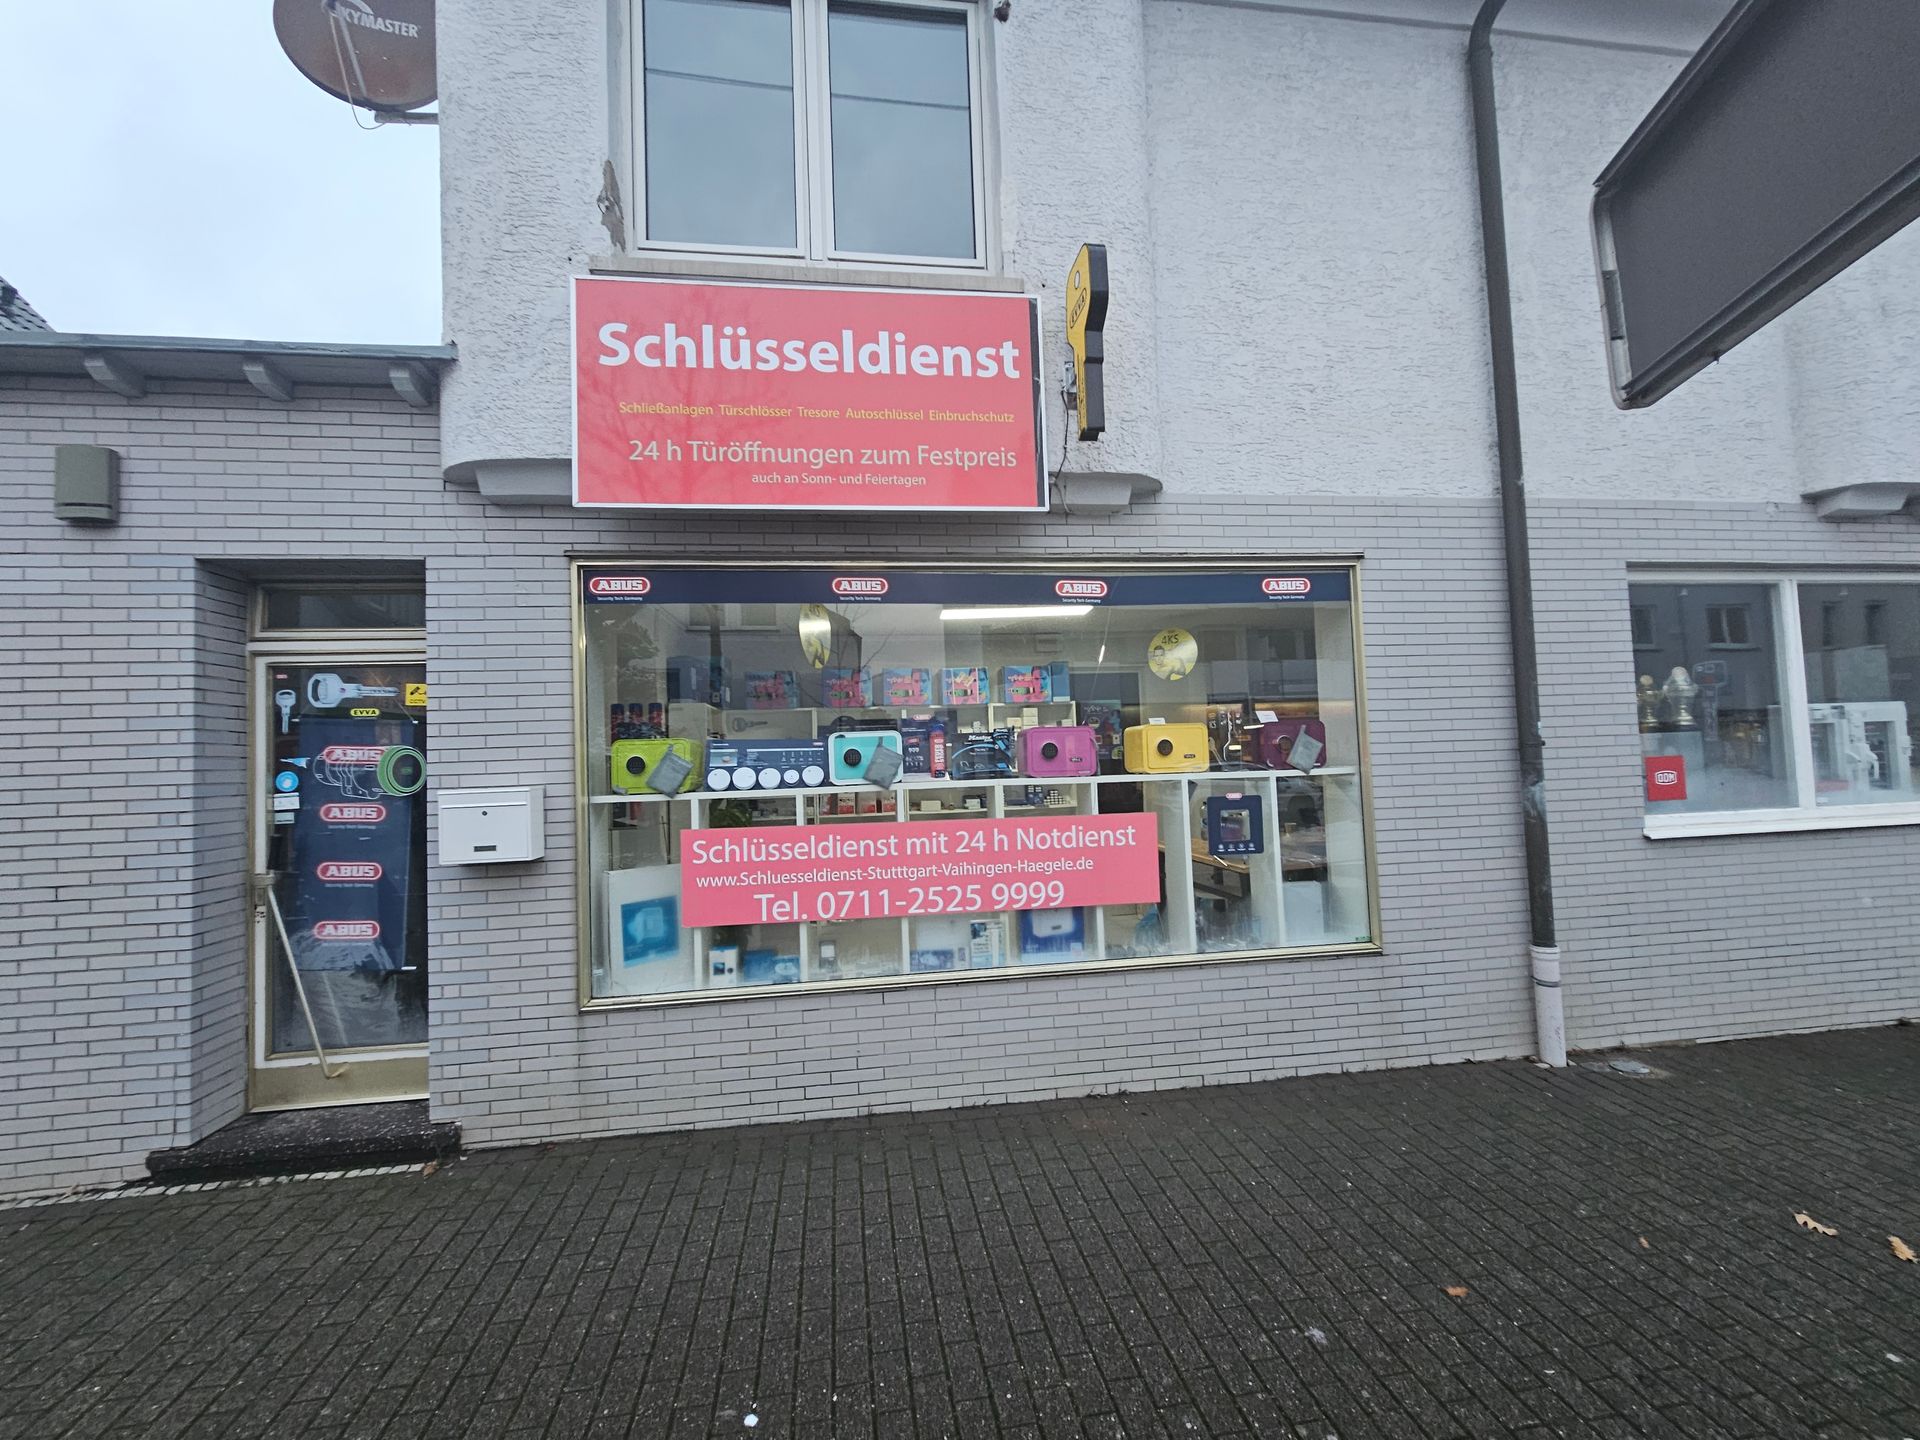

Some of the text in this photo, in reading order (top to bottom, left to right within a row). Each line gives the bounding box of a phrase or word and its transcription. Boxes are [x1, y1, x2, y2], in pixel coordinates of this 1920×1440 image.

[598, 322, 1021, 379] Schlüsseldienst
[619, 402, 1015, 423] Schließanlagen Türschlösser Tresore Autoschlüssel Einbruchschutz
[629, 439, 1017, 471] 24 h Türöffnungen zum Festpreis
[752, 472, 926, 487] auch an Sonn- und Feiertagen
[596, 579, 643, 591] ABUS
[839, 580, 882, 591] ABUS
[1062, 583, 1101, 593] ABUS
[1268, 580, 1305, 591] ABUS
[332, 749, 380, 761] ABUS
[328, 807, 378, 819] ABUS
[692, 825, 1136, 864] Schlüsseldienst mit 24 h Notdienst
[326, 865, 375, 877] ABUS
[753, 880, 1065, 922] Tel. 0711-2525 9999
[322, 924, 373, 935] ABUS
